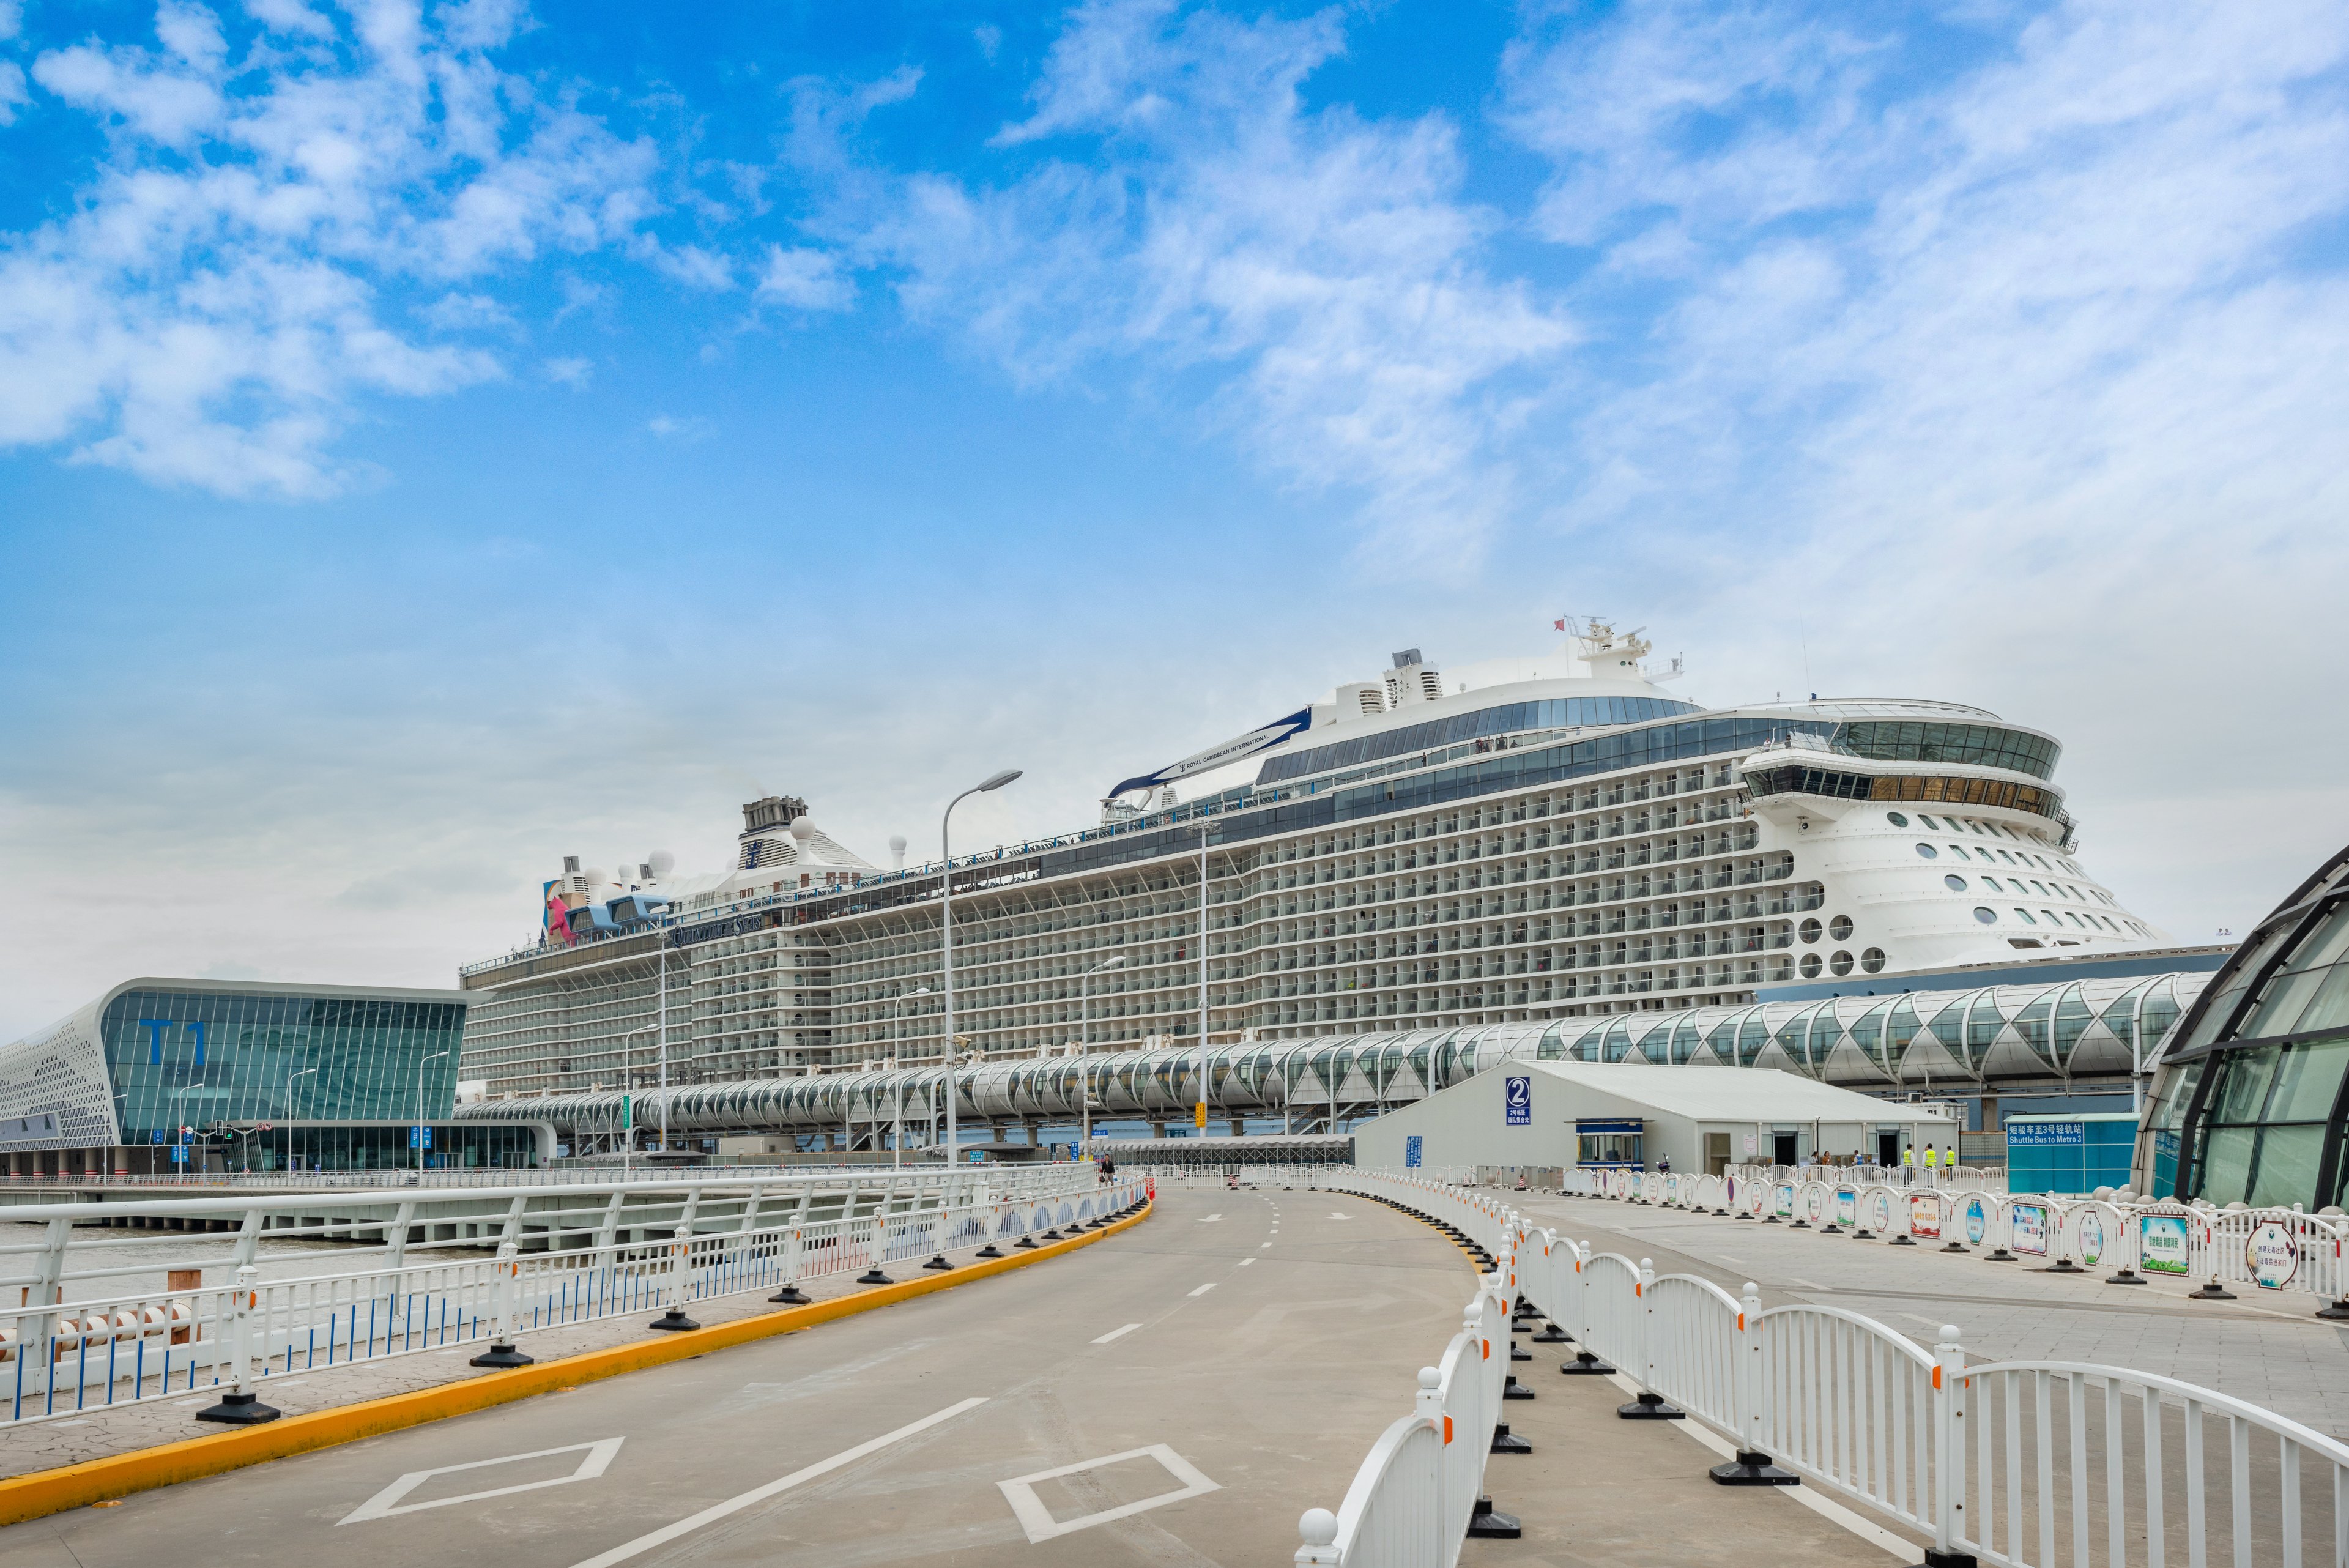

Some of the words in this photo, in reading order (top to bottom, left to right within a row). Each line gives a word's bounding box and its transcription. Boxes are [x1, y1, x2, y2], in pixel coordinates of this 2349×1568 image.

[1187, 760, 1201, 769] ROYAL
[1203, 749, 1230, 762] CARIBBEAN
[1231, 734, 1269, 752] INTERNATIONAL
[139, 1019, 205, 1065] T1
[1512, 1080, 1524, 1103] 2
[2009, 1124, 2082, 1135] 短驳车至3号轻轨站
[2164, 1237, 2178, 1249] 利国利民
[2258, 1245, 2285, 1255] 创建无毒社区
[2256, 1257, 2287, 1267] 不让毒品进家门
